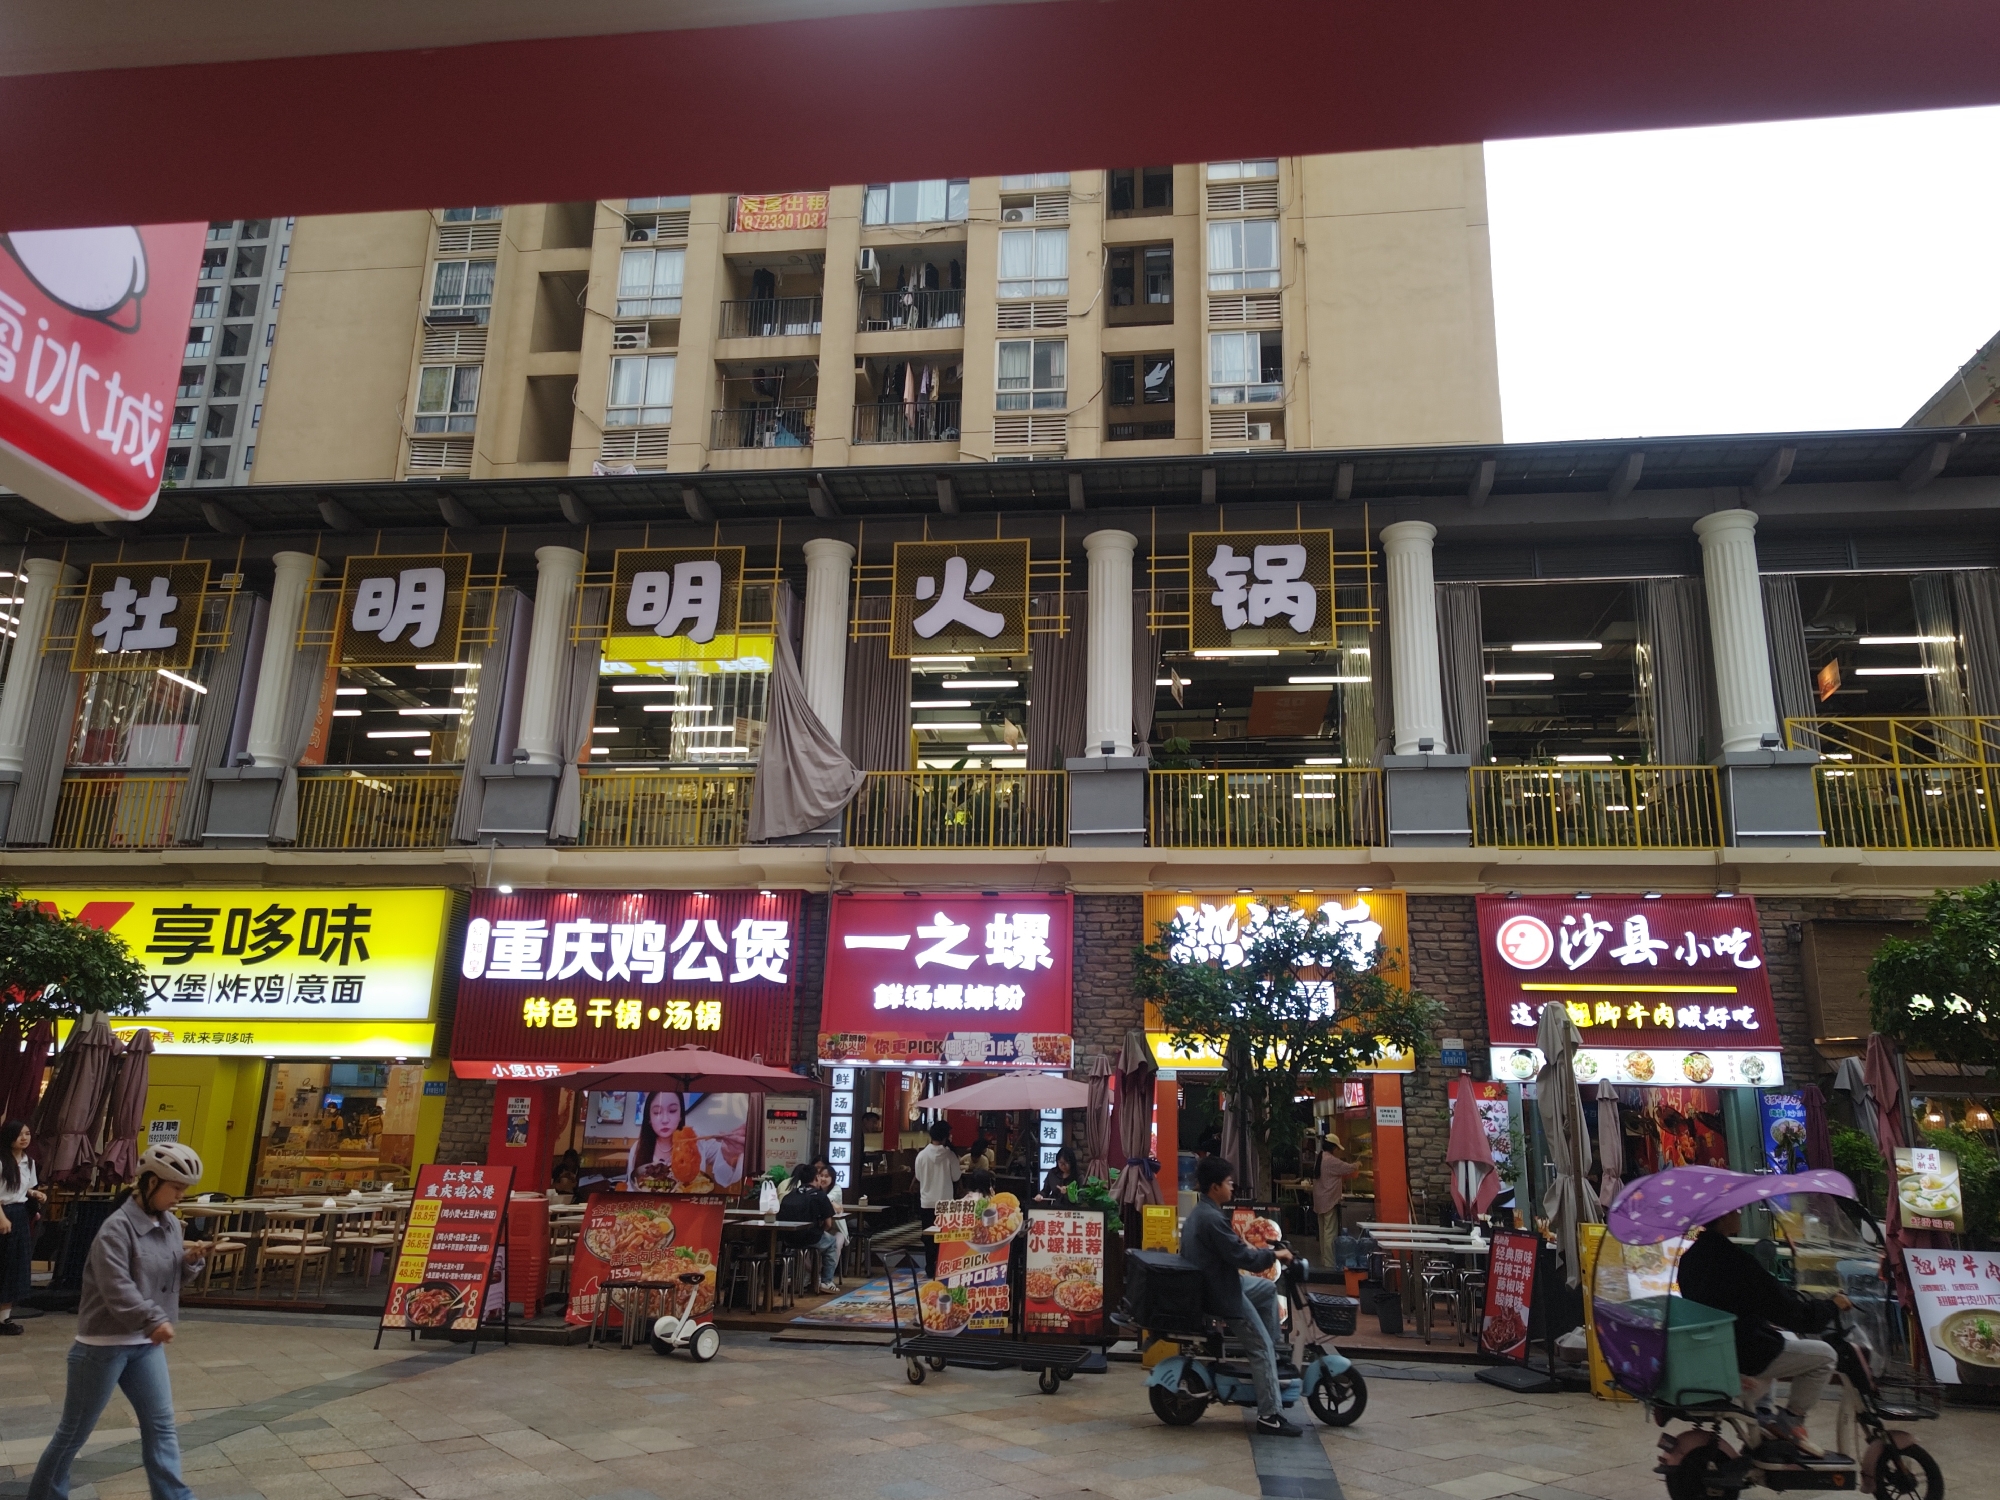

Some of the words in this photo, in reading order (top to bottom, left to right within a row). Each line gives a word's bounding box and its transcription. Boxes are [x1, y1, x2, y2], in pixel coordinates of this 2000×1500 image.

[740, 194, 827, 213] 房屋出租
[145, 903, 372, 966] 享哆味
[844, 912, 1054, 971] 一之螺
[1559, 912, 1762, 971] 沙县小吃
[485, 918, 790, 984] 重庆鸡公煲
[523, 997, 578, 1028] 特色
[1510, 1000, 1760, 1031] 这翘脚牛肉贼好吃
[182, 1031, 255, 1045] 就来享哆味
[151, 1121, 179, 1132] 招聘
[425, 1183, 496, 1200] 重庆鸡公煲
[412, 1211, 437, 1222] 18.8元
[935, 1200, 976, 1214] 螺蛳粉
[934, 1213, 975, 1228] 小火锅
[1030, 1220, 1103, 1238] 爆款上新
[405, 1239, 430, 1250] 36.8元
[1029, 1236, 1103, 1256] 小螺推荐
[938, 1253, 989, 1275] 你更PICK
[1495, 1246, 1533, 1265] 经典原味
[398, 1268, 423, 1279] 48.8元
[1494, 1261, 1531, 1280] 麻辣干拌
[1911, 1254, 2000, 1281] 翘脚牛肉
[967, 1297, 1009, 1314] 小火锅
[1936, 1294, 2000, 1306] 翘脚牛肉少不
